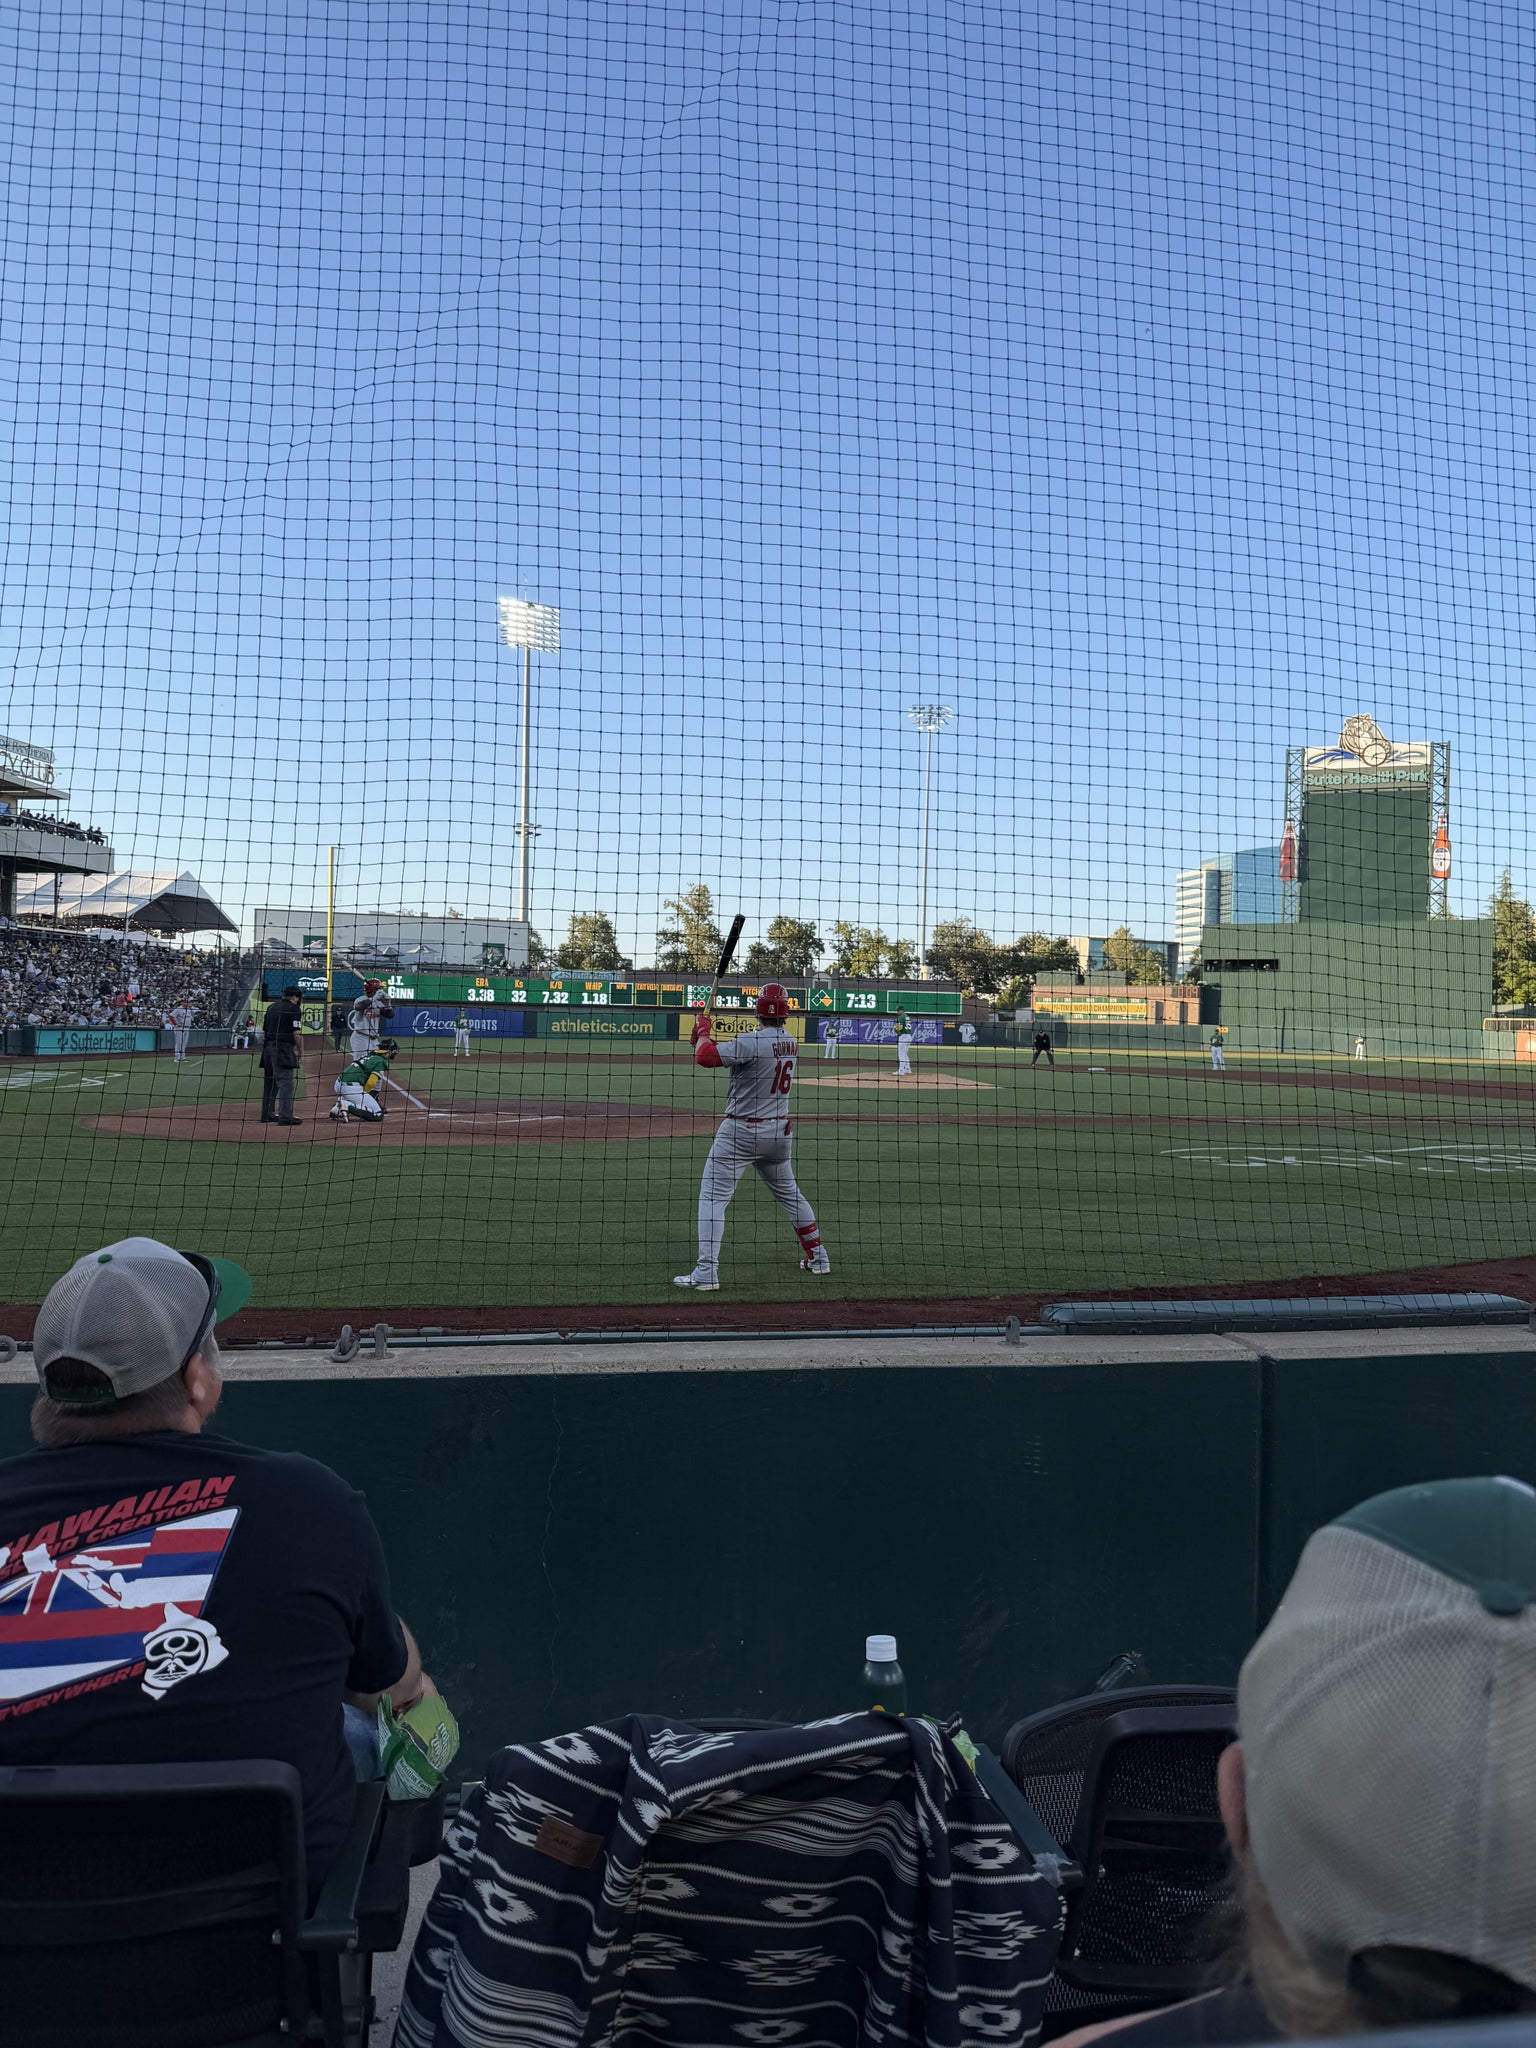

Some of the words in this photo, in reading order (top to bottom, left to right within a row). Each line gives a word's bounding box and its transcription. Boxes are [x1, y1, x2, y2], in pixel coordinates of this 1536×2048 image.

[1304, 774, 1347, 785] Sutter
[1349, 771, 1394, 784] Health
[1396, 770, 1428, 782] Park
[388, 975, 404, 986] J.T.
[475, 978, 489, 987] ERA
[514, 980, 524, 988] Ks
[388, 986, 415, 999] GINN
[467, 988, 495, 1002] 3.38
[511, 990, 527, 1003] 32
[542, 991, 569, 1004] 7.32
[581, 992, 608, 1005] 1.18
[846, 993, 877, 1009] 7:13
[412, 1010, 456, 1034] Circa
[464, 1019, 498, 1031] PORTS
[551, 1018, 653, 1034] athletics.com
[711, 1018, 754, 1033] Golde
[70, 1032, 104, 1051] Sutter
[105, 1031, 136, 1050] Health
[770, 1060, 794, 1095] 16
[5, 1475, 236, 1563] HAWAIIAN
[0, 1536, 79, 1580] SLND
[86, 1495, 227, 1543] CREATIONS
